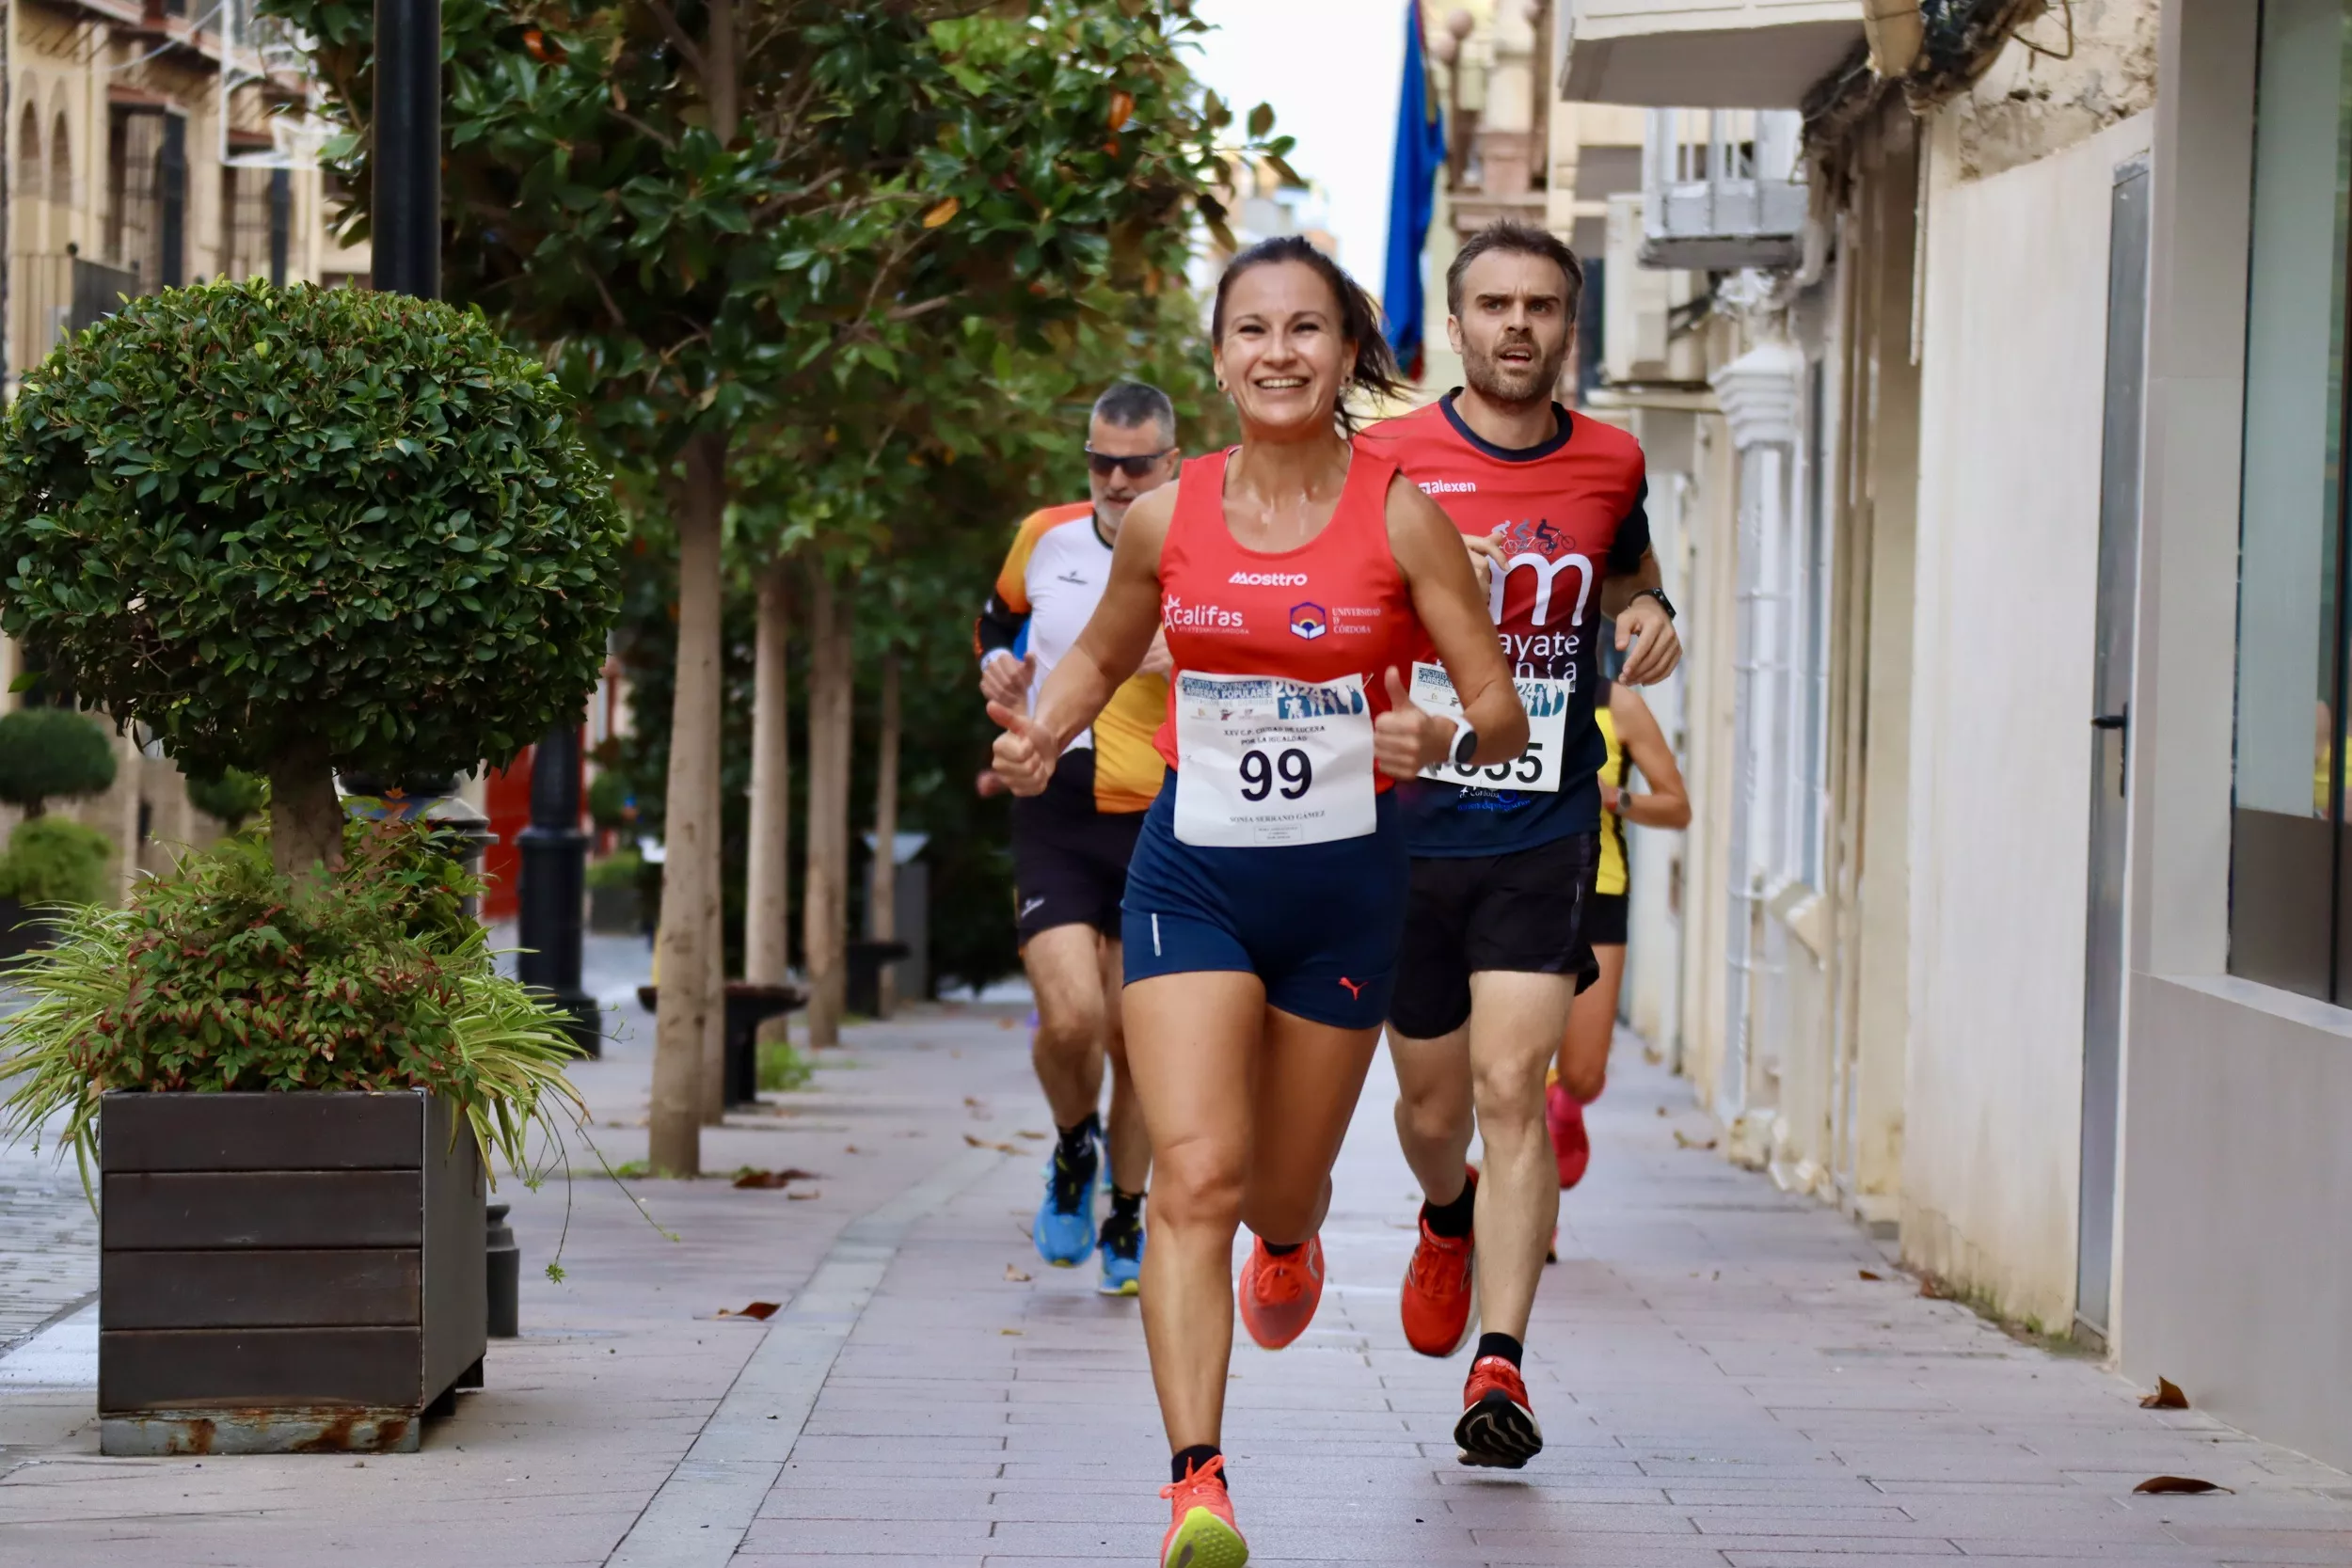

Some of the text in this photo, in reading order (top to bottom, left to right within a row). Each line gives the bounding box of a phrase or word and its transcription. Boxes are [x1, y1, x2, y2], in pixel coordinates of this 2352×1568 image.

[1173, 605, 1243, 627] califas
[1331, 608, 1381, 617] UNIVERSIDAD
[1212, 681, 1260, 691] PROVINCIAL
[1221, 688, 1273, 699] POPULARES
[1239, 748, 1312, 801] 99
